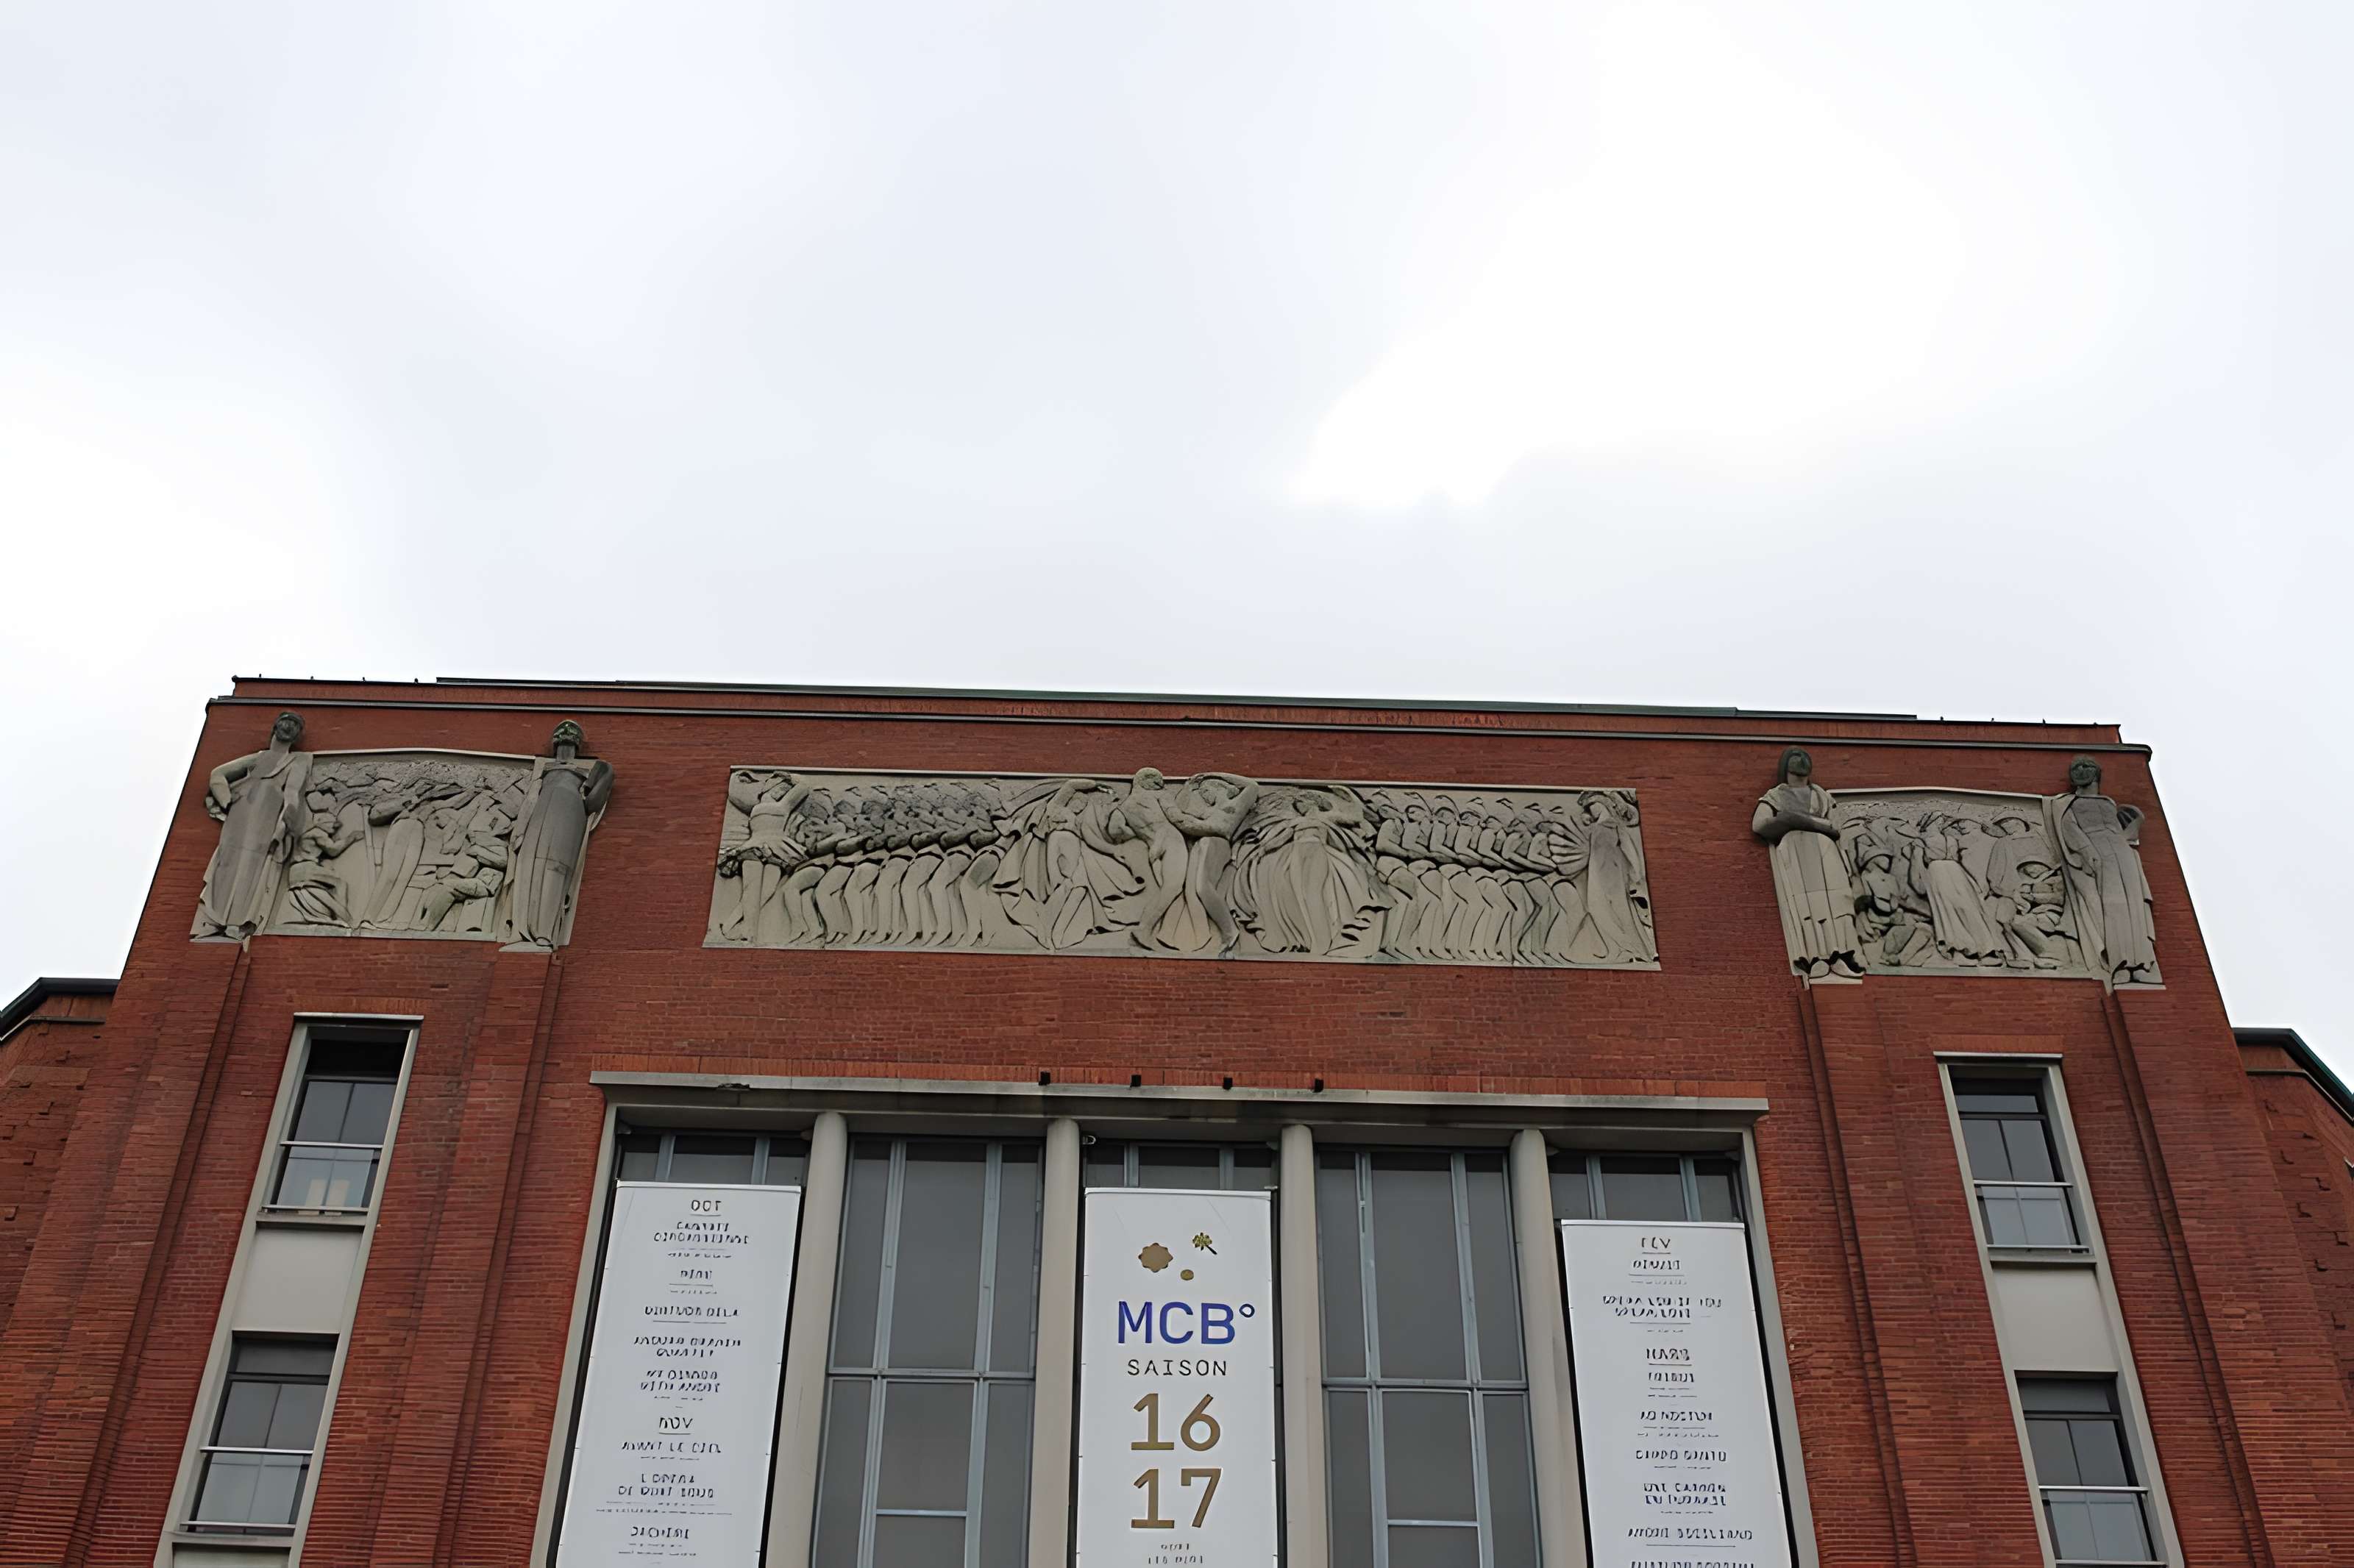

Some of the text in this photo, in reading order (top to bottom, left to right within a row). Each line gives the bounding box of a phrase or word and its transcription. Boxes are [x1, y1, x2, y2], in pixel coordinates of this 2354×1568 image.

[1127, 1358, 1227, 1377] SAISON
[1131, 1393, 1221, 1452] 16
[1131, 1468, 1223, 1529] 17
